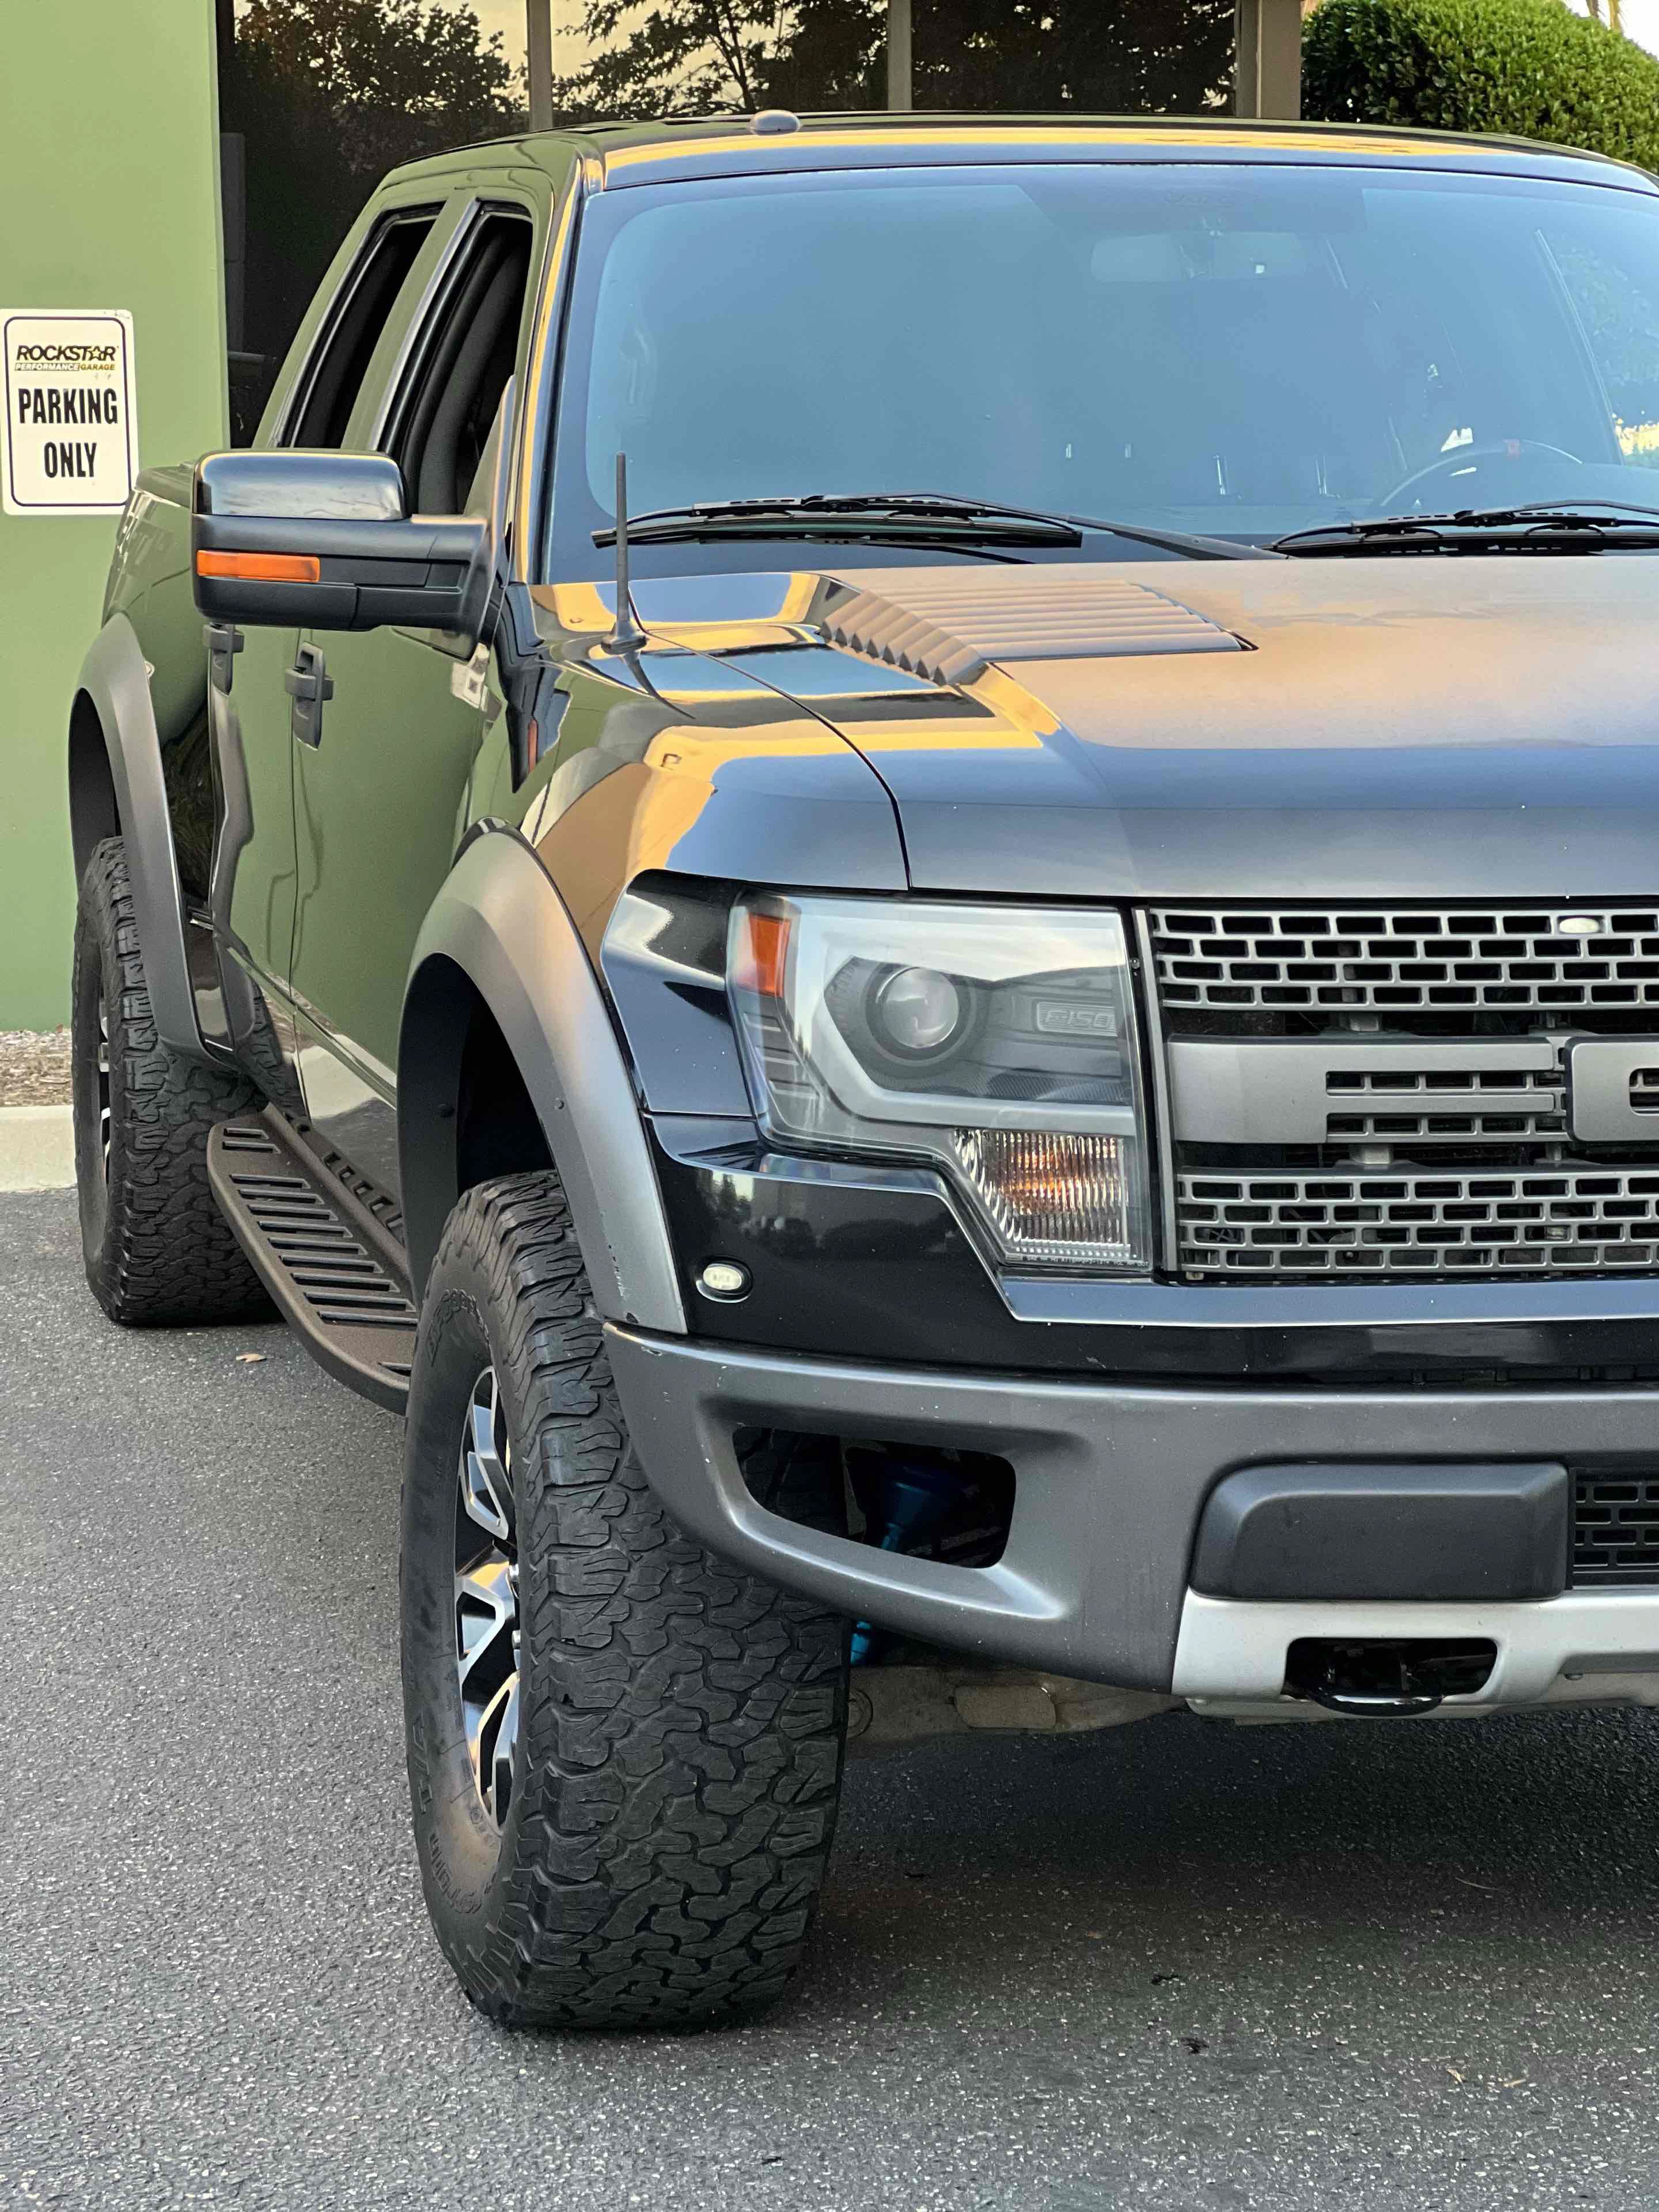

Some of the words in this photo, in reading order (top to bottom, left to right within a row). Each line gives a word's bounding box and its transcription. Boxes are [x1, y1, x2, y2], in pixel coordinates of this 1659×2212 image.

[16, 345, 116, 361] ROCKSTAR
[16, 363, 79, 371] PERFORMANCE
[18, 388, 118, 424] PARKING
[44, 442, 97, 478] ONLY
